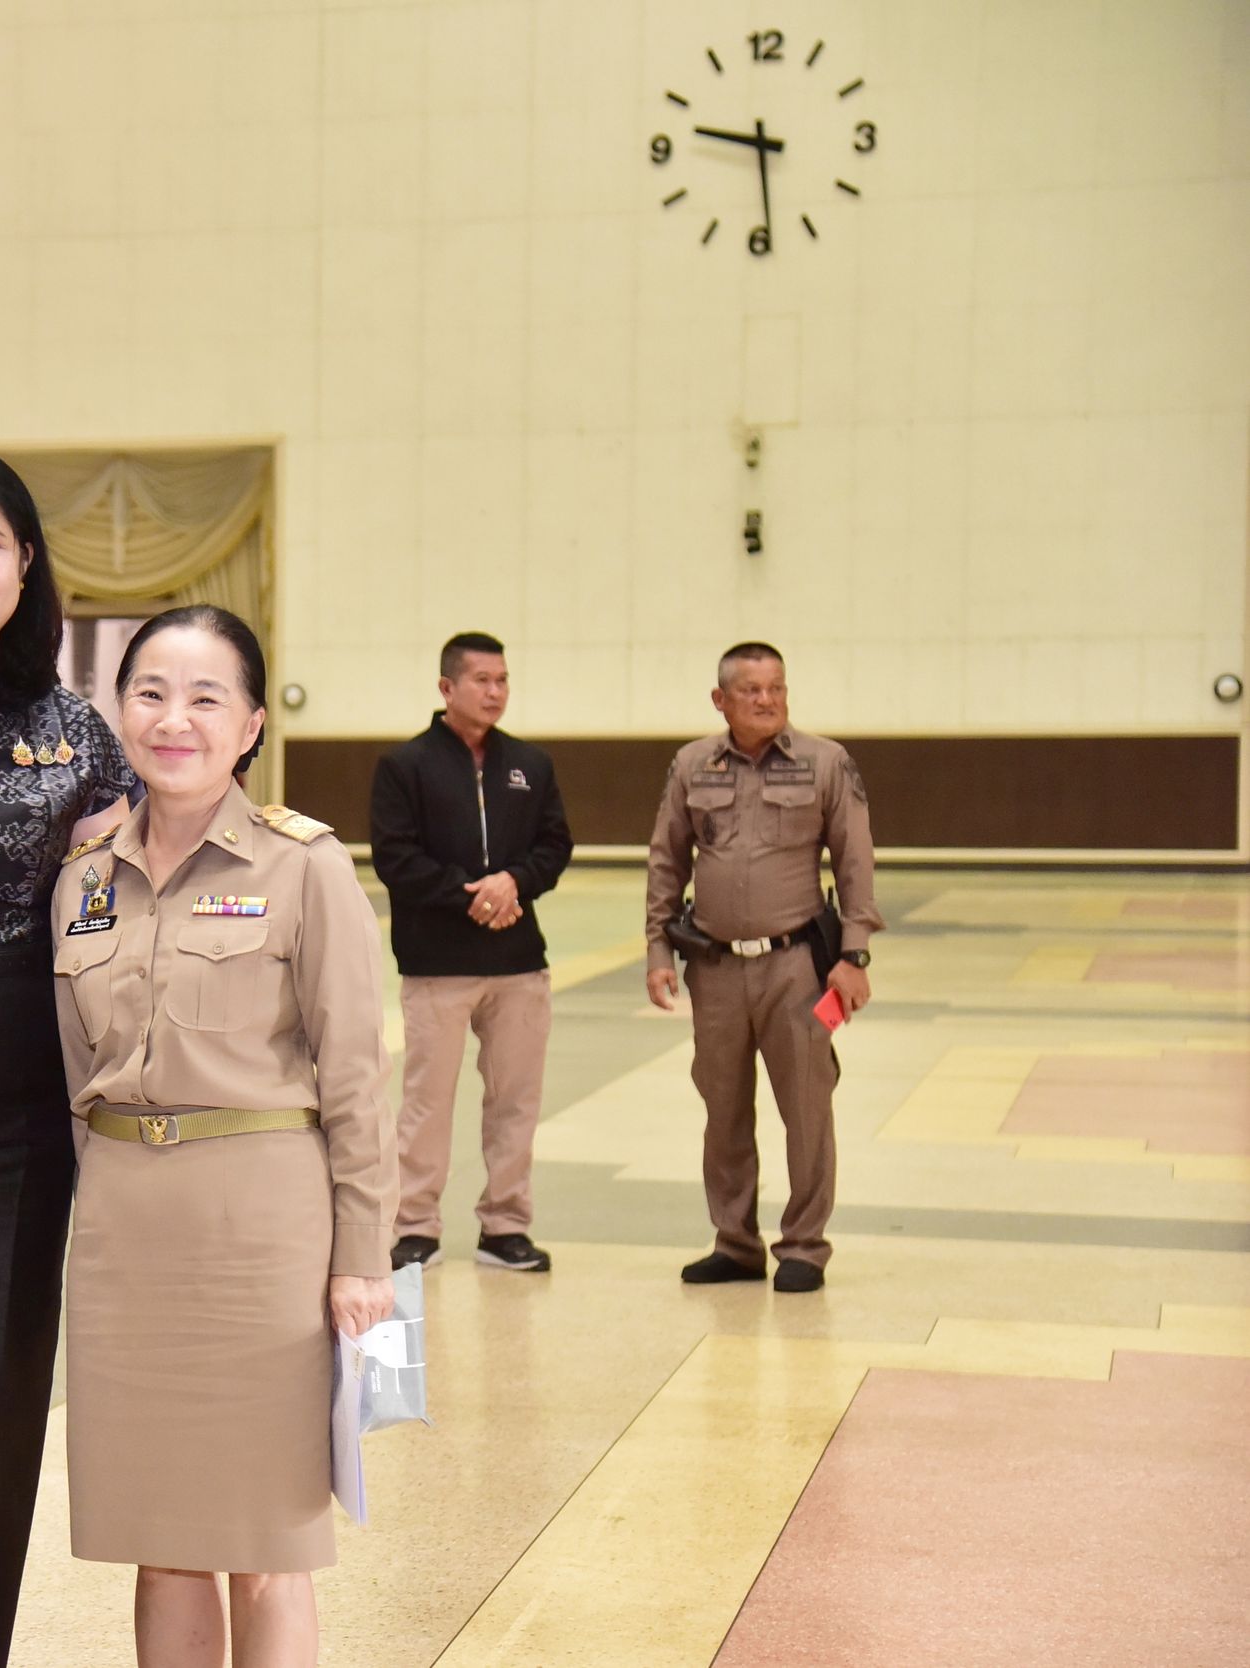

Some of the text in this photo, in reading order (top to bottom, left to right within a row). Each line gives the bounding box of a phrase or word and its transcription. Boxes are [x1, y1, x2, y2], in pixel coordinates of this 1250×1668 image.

[748, 30, 784, 61] 12
[651, 134, 672, 164] 9
[854, 122, 876, 153] 3
[748, 226, 771, 257] 6
